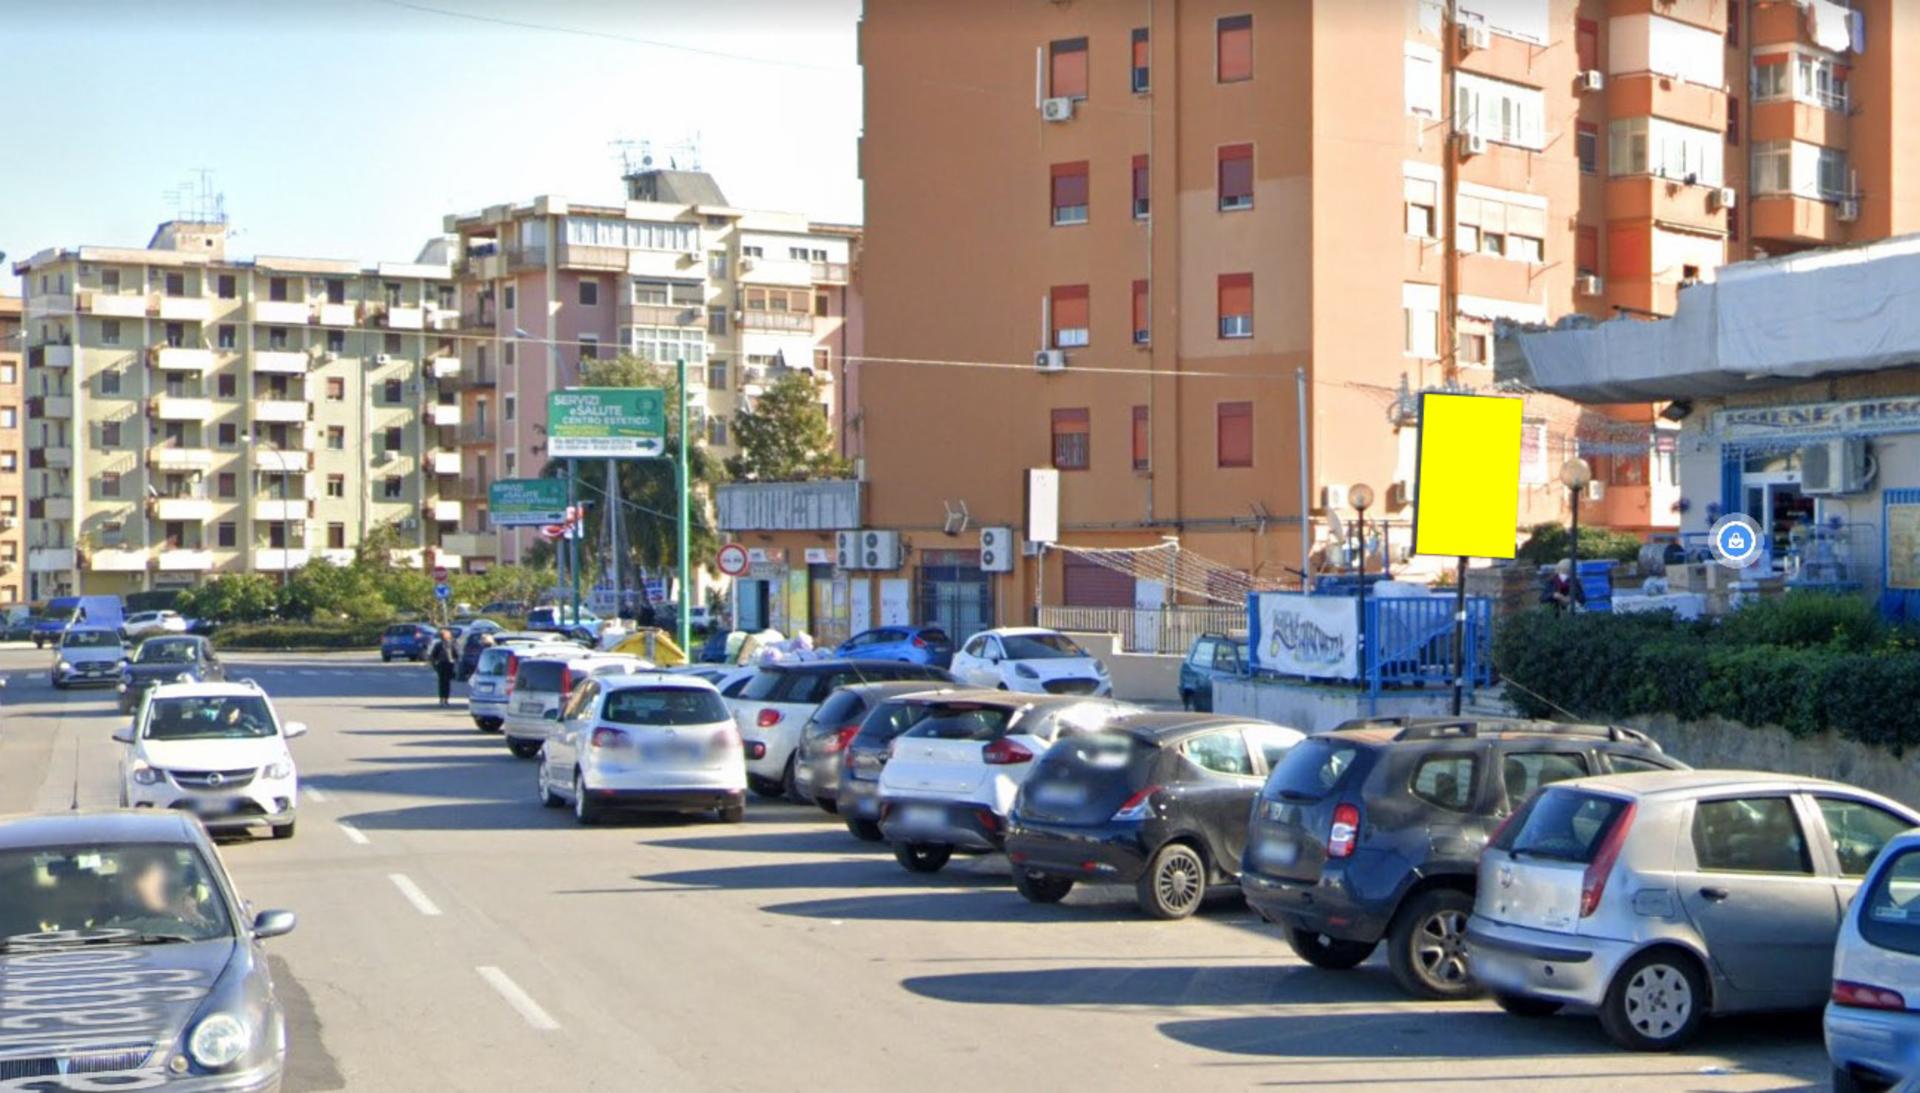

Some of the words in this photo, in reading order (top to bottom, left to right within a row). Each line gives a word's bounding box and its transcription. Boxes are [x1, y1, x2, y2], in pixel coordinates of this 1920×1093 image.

[554, 395, 600, 405] SERVIZI
[562, 416, 601, 425] CENTRO
[604, 416, 650, 425] ESTETICO
